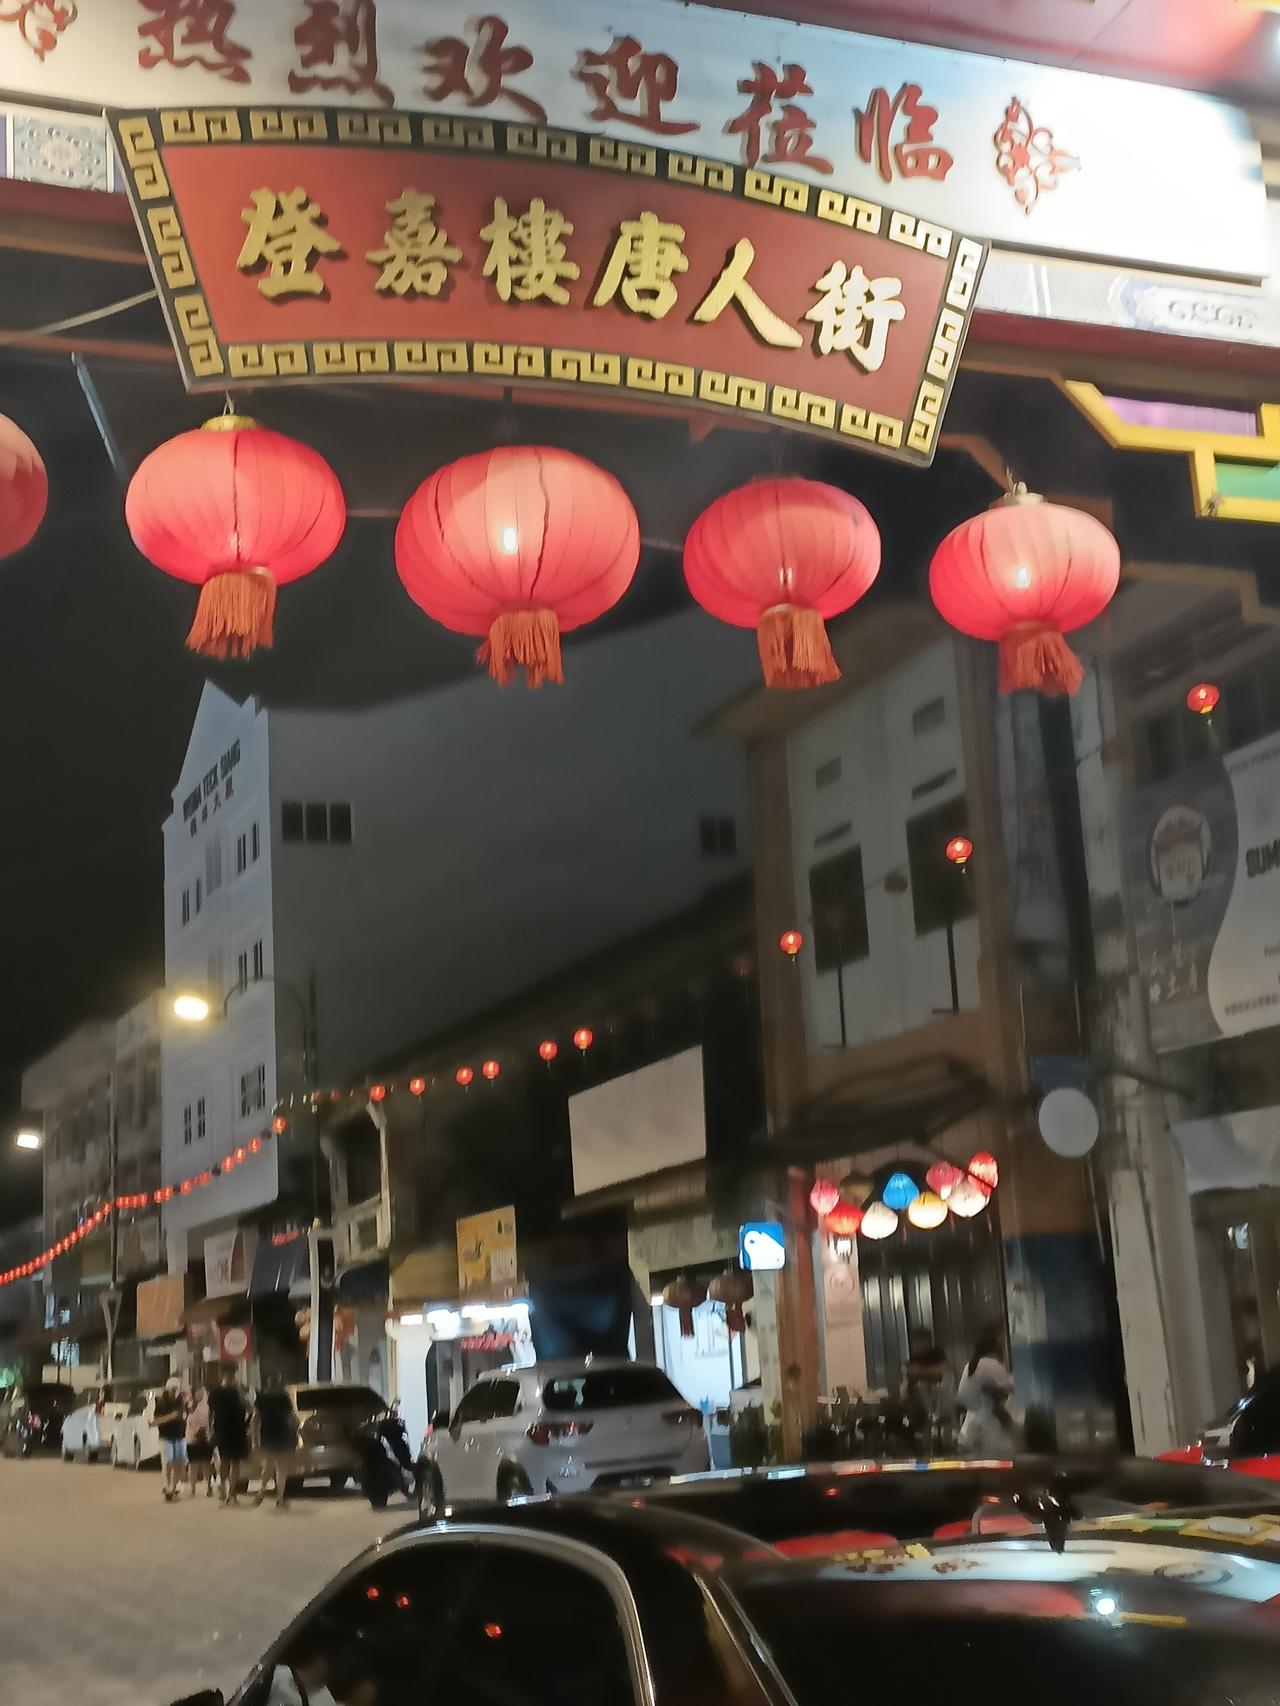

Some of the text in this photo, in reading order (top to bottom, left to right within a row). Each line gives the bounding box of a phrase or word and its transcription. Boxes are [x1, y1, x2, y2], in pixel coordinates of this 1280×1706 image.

[137, 0, 954, 183] 热烈欢迎莅临
[237, 187, 906, 372] 登嘉樓唐人街
